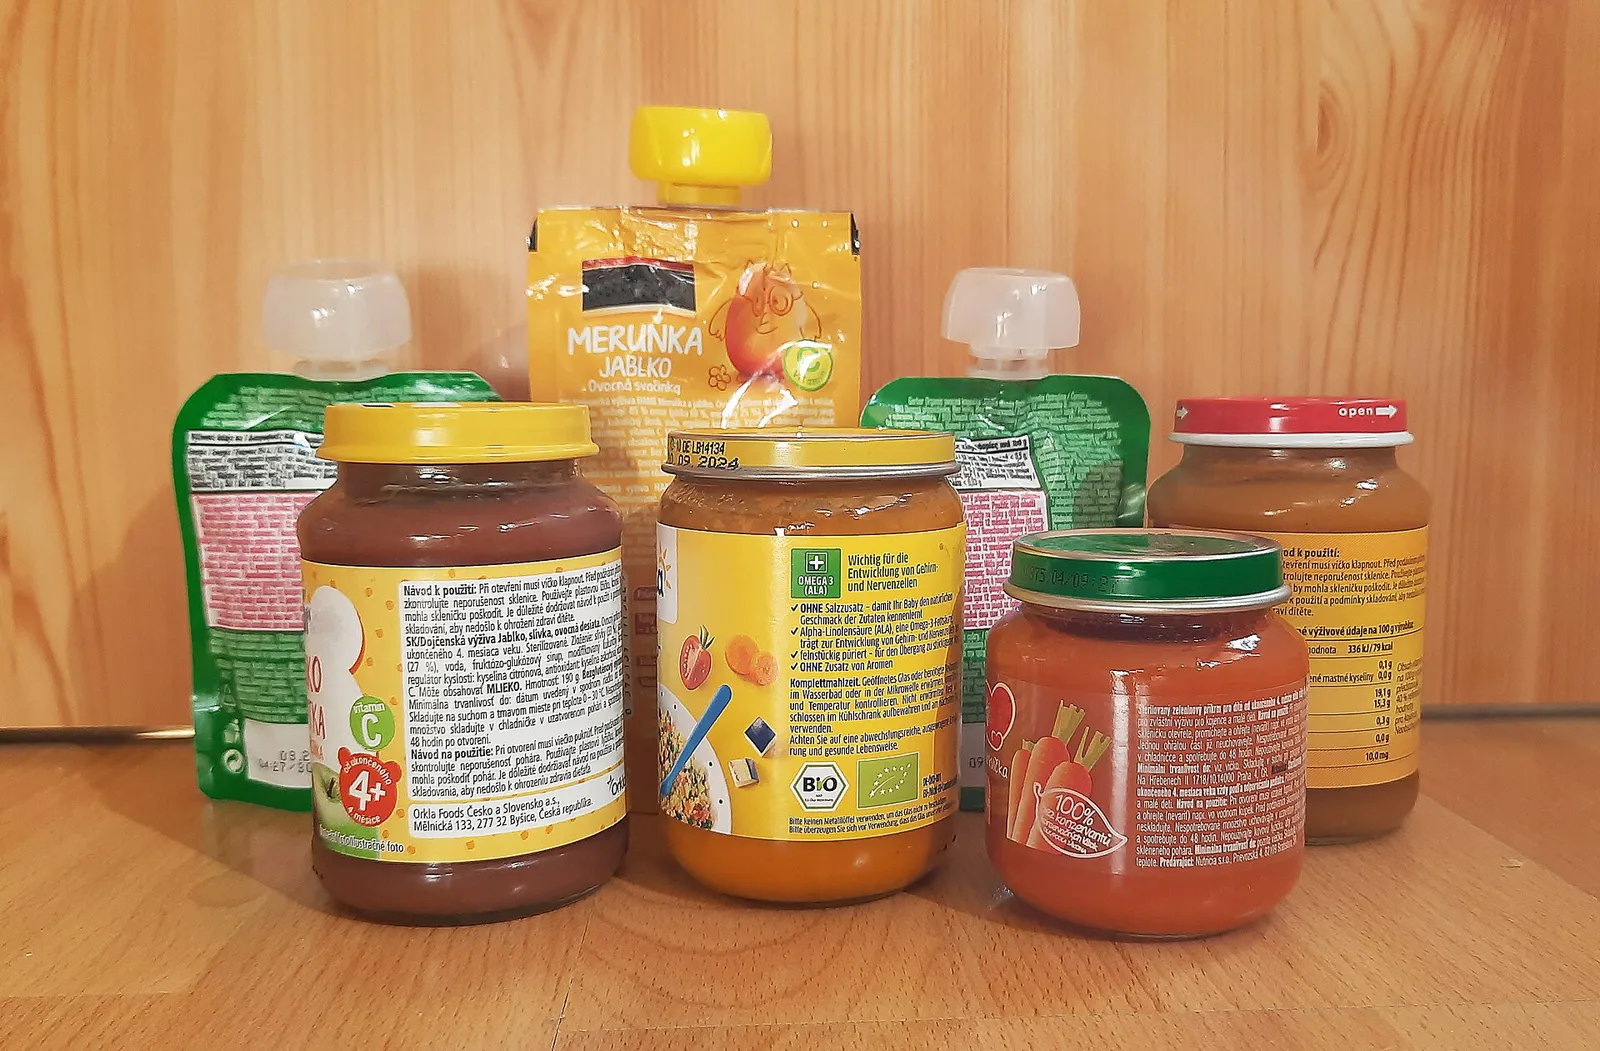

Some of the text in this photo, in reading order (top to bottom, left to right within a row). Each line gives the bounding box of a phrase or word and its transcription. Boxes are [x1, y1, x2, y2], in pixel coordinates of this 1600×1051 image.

[599, 356, 671, 378] JABLKO
[587, 380, 680, 395] Ovocná svačinka
[1339, 406, 1373, 417] open
[698, 456, 738, 470] 2024
[848, 552, 908, 566] Wichtig für die
[1298, 548, 1302, 556] k
[1305, 548, 1339, 559] použití:
[848, 566, 899, 578] Entwicklung
[901, 566, 914, 575] von
[1282, 561, 1310, 569] tevření
[1312, 561, 1329, 569] musí
[1332, 561, 1350, 569] víčko
[1352, 560, 1382, 571] klapnout.
[799, 576, 827, 585] OMEGA
[1283, 573, 1363, 582] trolujte neporušenost
[404, 585, 432, 596] Návod
[435, 586, 440, 595] k
[443, 585, 476, 598] použití:
[492, 581, 521, 593] otevření
[523, 579, 539, 590] musí
[542, 576, 558, 588] víčko
[805, 586, 827, 595] (ALA)
[848, 578, 917, 591] und Nervenzellen
[1293, 584, 1302, 593] by
[1330, 584, 1362, 593] skleničku
[1364, 582, 1391, 593] poškodit.
[800, 603, 823, 613] OHNE
[825, 602, 863, 613] Salzzusatz
[872, 600, 891, 611] damit
[904, 598, 918, 610] Baby
[920, 597, 929, 606] den
[1296, 596, 1322, 605] použití
[1330, 596, 1365, 606] podmínky
[800, 610, 922, 625] Geschmack der Zutaten kennenlernt
[1289, 607, 1313, 616] dítěte.
[405, 612, 575, 636] skladování, aby nedošlo k ohrožení zdraví dítěte.
[406, 623, 578, 649] SK/Dojčenská výživa Jablko, slivka, ovocná
[800, 624, 893, 638] Alpha-Linolensäure (ALA),
[1309, 627, 1345, 638] výživové
[1346, 627, 1368, 637] údaje
[1379, 625, 1389, 633] 100
[800, 636, 879, 649] trägt zur Entwicklung
[1348, 645, 1360, 653] 336
[800, 649, 866, 661] feinstückig püriert
[800, 659, 893, 672] OHNE Zusatz von Aromen
[790, 678, 860, 689] Komplettmahlzeit.
[1323, 673, 1348, 682] mastné
[1349, 671, 1374, 683] kyseliny
[419, 683, 522, 697] Môže obsahovať MLIEKO.
[790, 689, 861, 699] im Wasserbad oder
[362, 714, 381, 747] C
[790, 724, 833, 733] verwenden.
[411, 737, 420, 746] 48
[446, 737, 455, 748] po
[457, 733, 491, 745] otvorení.
[790, 732, 858, 745] Achten Sie auf eine
[411, 746, 493, 760] Návod na použitie:
[790, 742, 898, 757] rung und gesunde Lebensweise.
[351, 756, 392, 785] ukončeného
[350, 770, 386, 811] 4+
[413, 808, 436, 819] Orkla
[439, 807, 464, 818] Foods
[467, 804, 493, 816] Česko
[495, 805, 501, 814] a
[504, 799, 543, 814] Slovensko
[414, 798, 593, 832] Mělnická 133, 277 32 Byšice, Česká republika.
[1056, 794, 1095, 825] 100%
[354, 811, 381, 824] měsíce
[387, 841, 403, 852] foto
